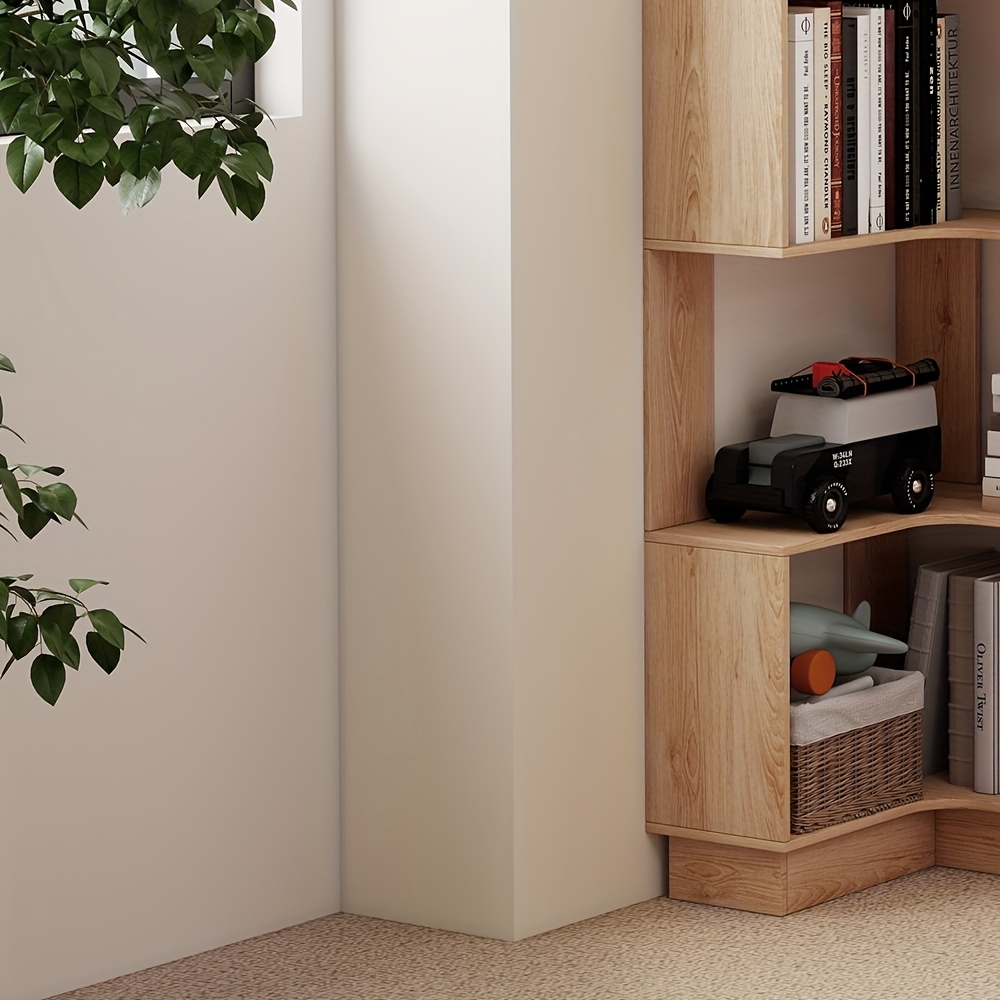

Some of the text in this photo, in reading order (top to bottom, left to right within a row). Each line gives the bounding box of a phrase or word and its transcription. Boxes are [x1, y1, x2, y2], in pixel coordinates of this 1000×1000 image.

[948, 27, 960, 191] INNENARCHITEKTUR
[976, 643, 986, 731] OLIVER TWIST
